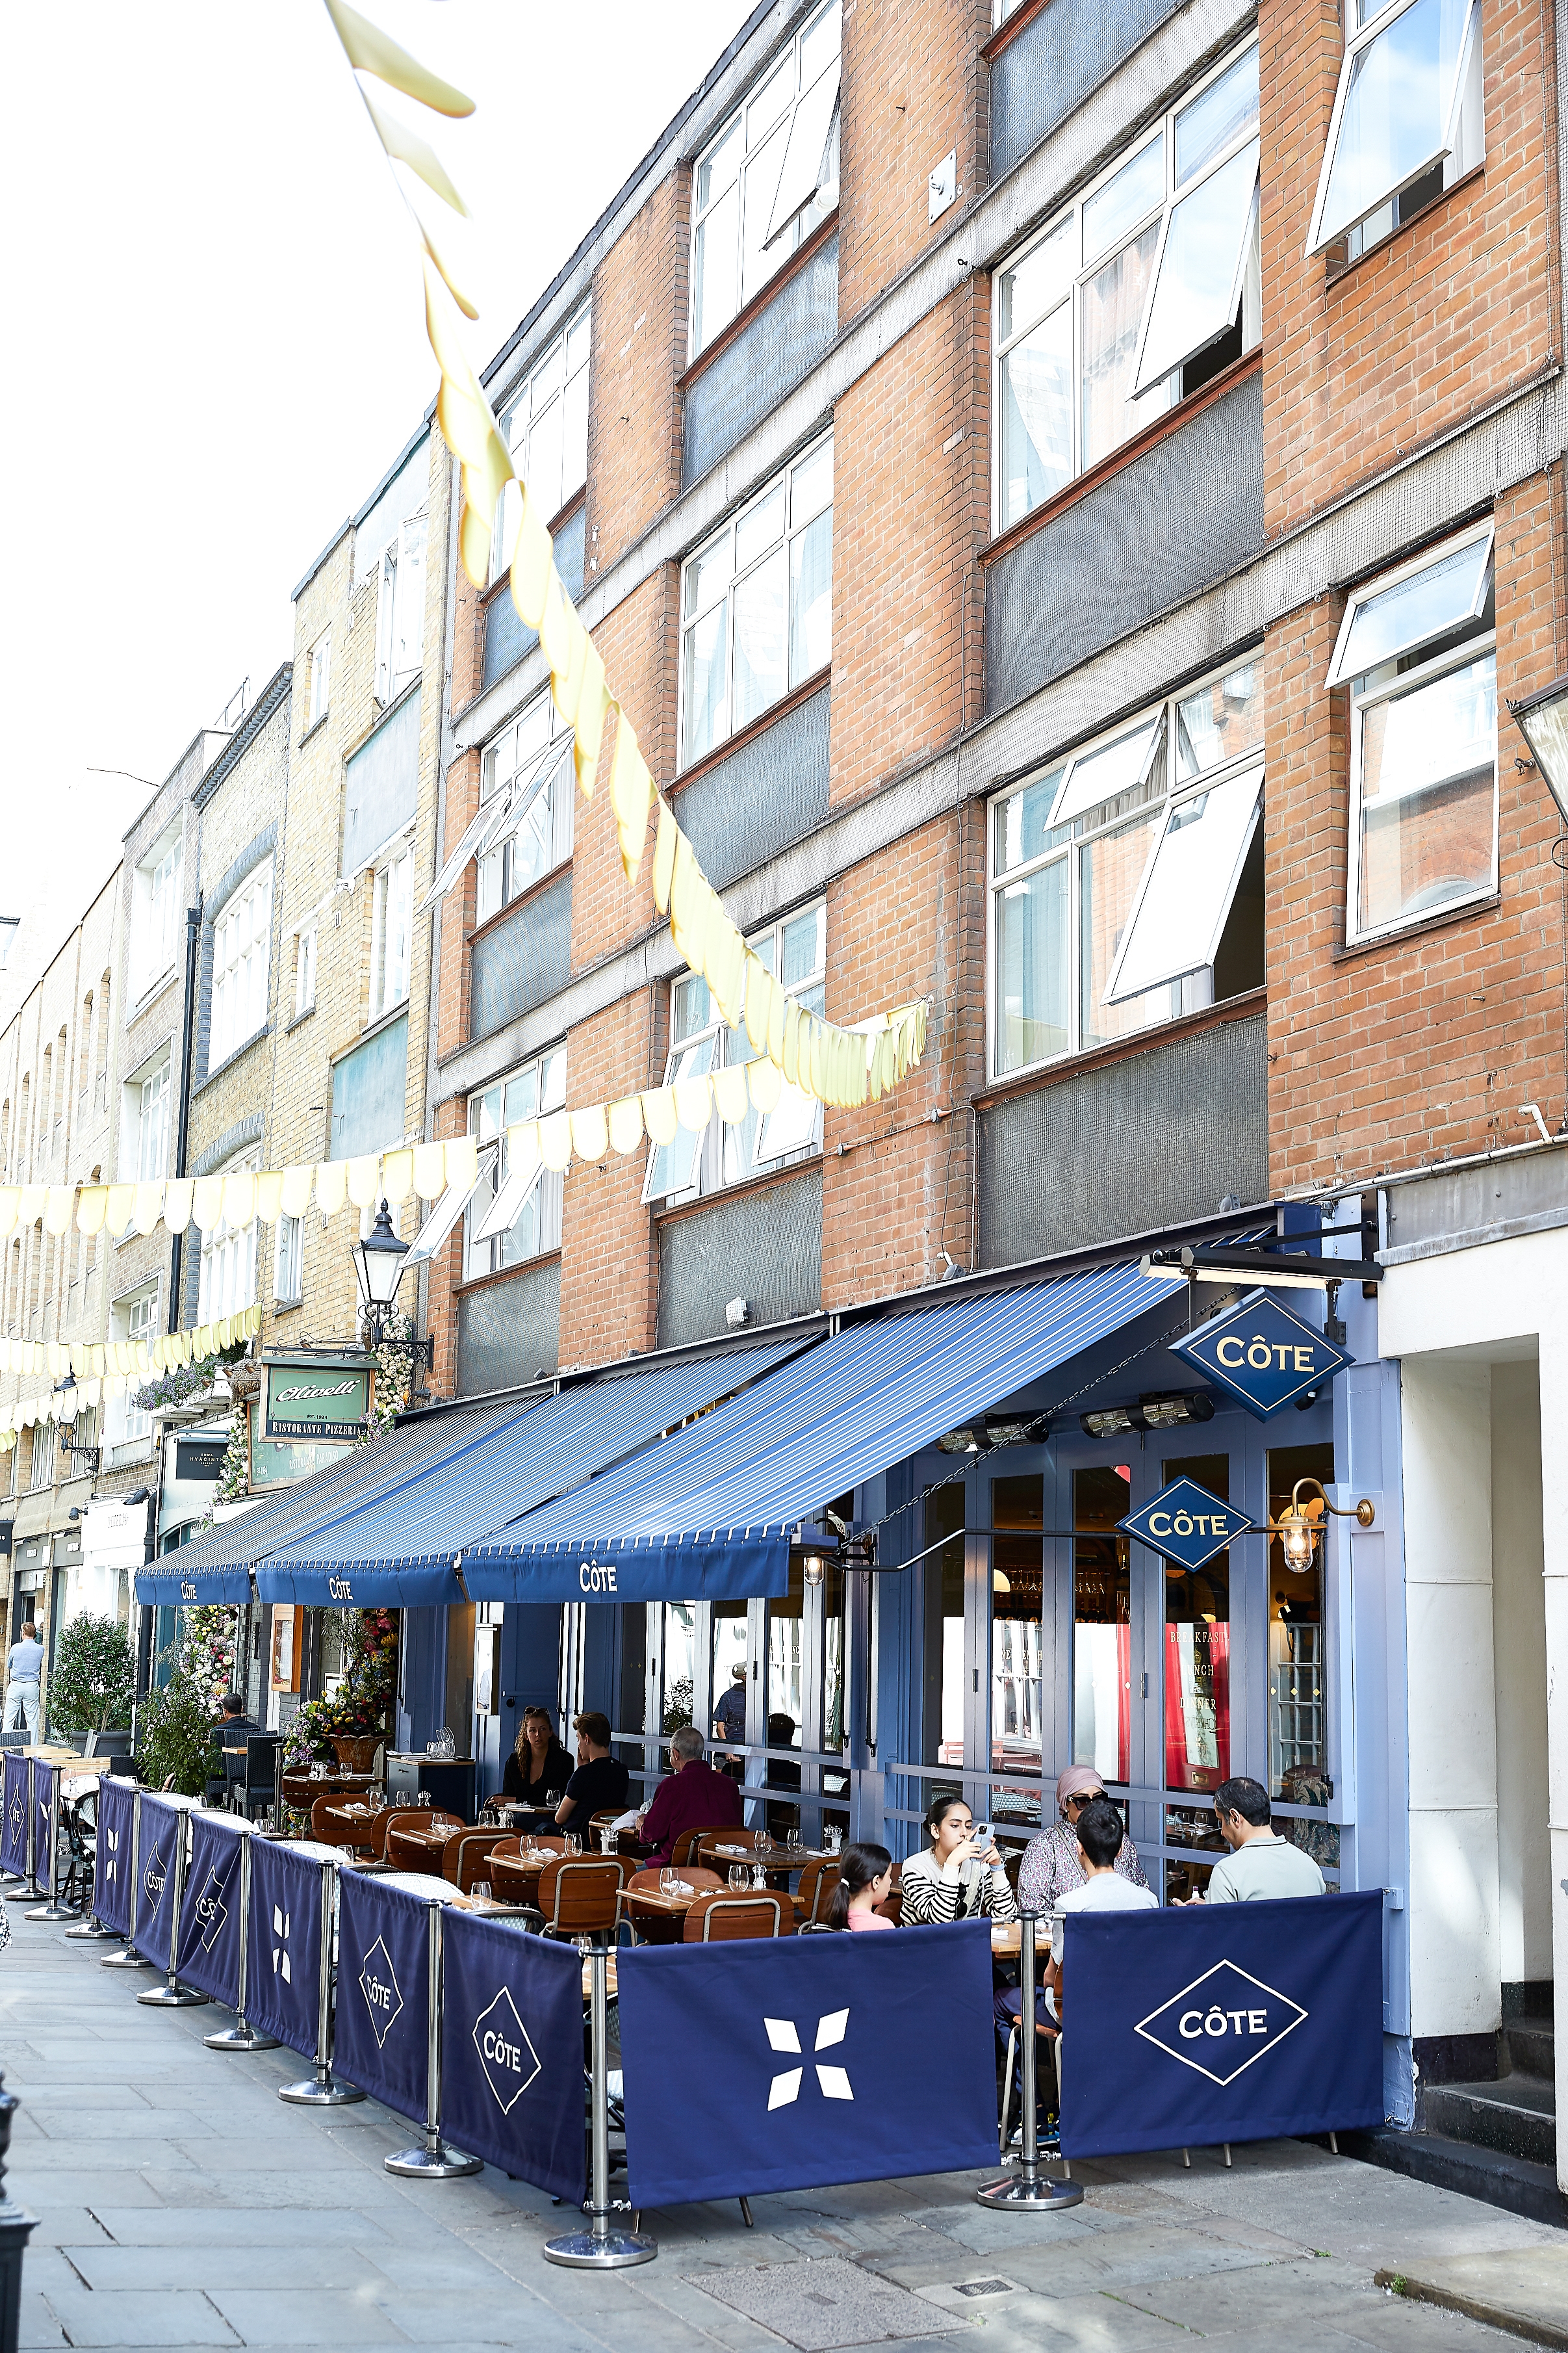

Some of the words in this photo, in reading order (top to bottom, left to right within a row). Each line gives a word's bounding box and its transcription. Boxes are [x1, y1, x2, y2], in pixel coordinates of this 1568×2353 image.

[1216, 1334, 1315, 1373] CÔTE
[276, 1379, 361, 1403] Olivelli
[272, 1421, 322, 1435] RISTORANTE
[325, 1424, 361, 1435] PIZZERIA
[316, 1450, 339, 1465] PARADISO
[1148, 1509, 1229, 1537] CÔTE
[579, 1559, 617, 1592] CÔTE
[181, 1580, 198, 1601] CÔTE
[329, 1576, 353, 1600] CÔTE
[1170, 1632, 1226, 1643] BREAKFAST
[1181, 1665, 1215, 1676] LUNCH
[1179, 1697, 1216, 1710] DINNER
[367, 1975, 391, 2010] CÔTE
[1179, 2005, 1267, 2039] CÔTE
[483, 2031, 521, 2073] CÔTE
